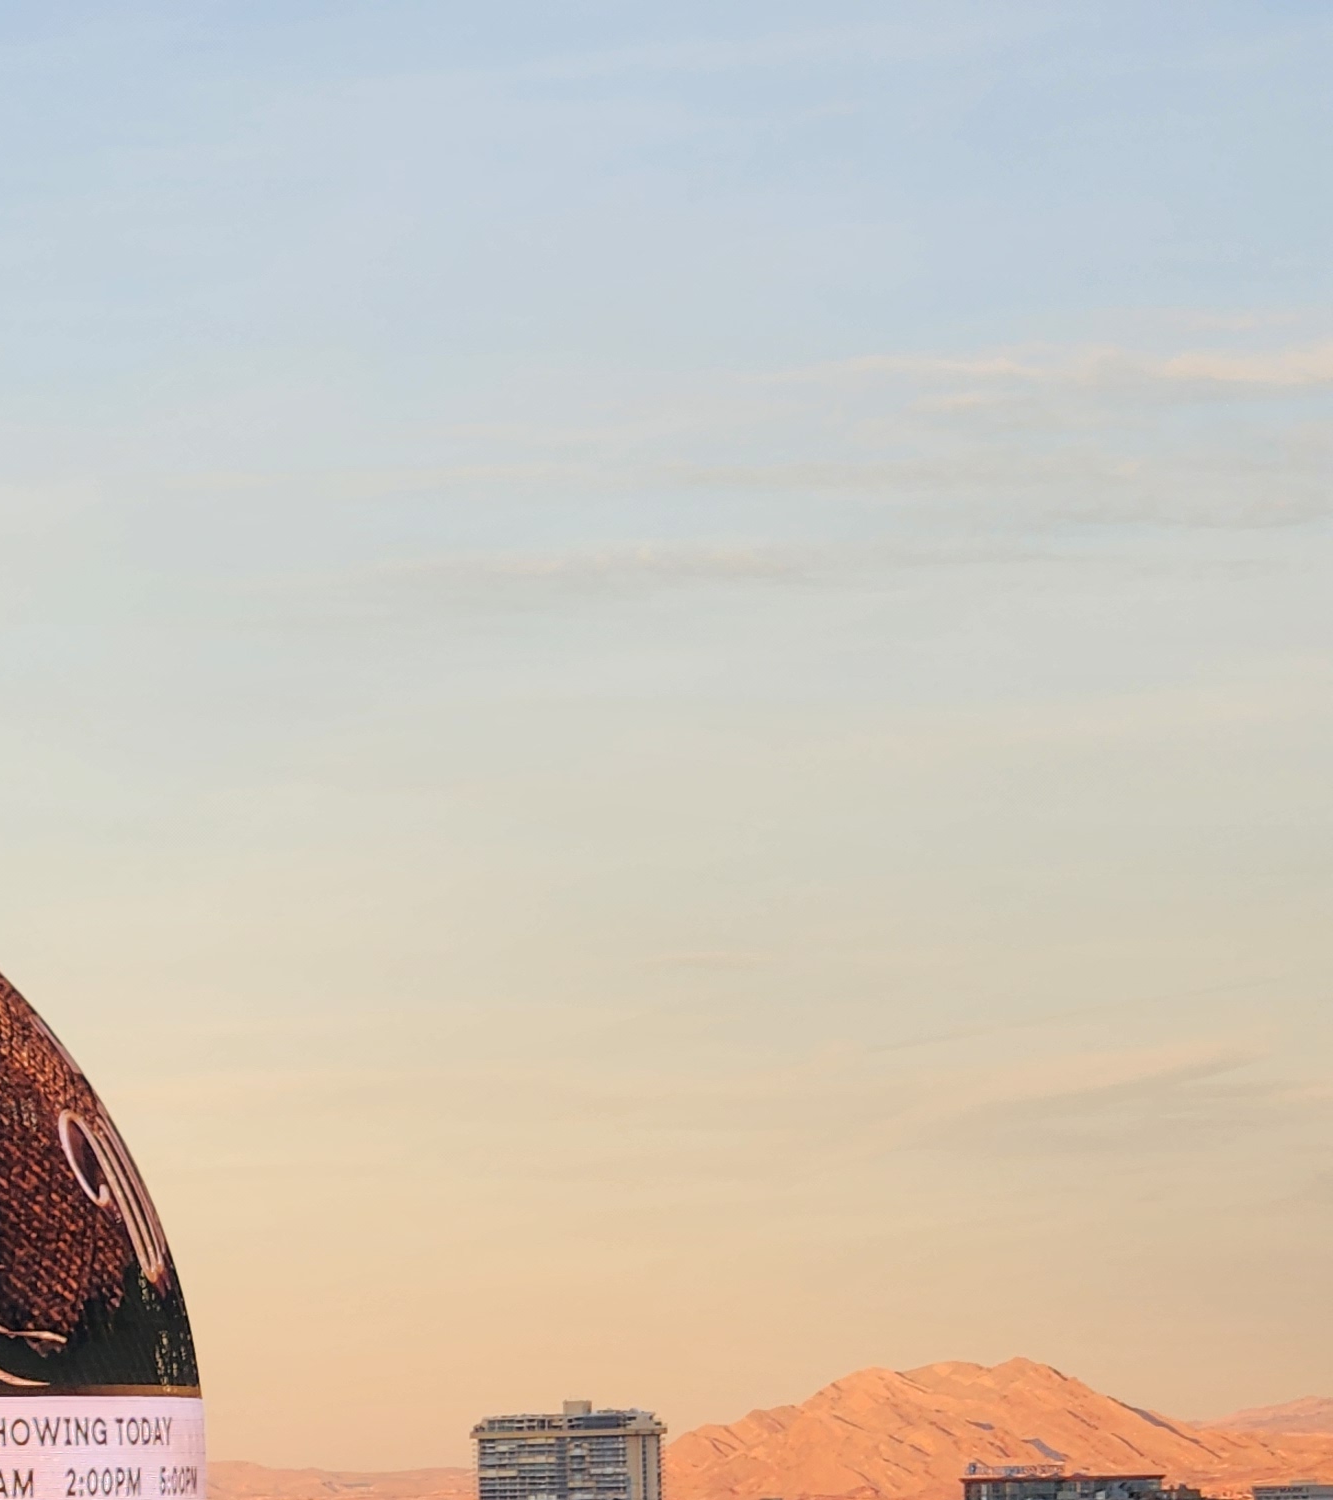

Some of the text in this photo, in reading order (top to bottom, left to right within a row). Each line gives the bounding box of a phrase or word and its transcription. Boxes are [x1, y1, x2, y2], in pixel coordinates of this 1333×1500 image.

[117, 1416, 173, 1447] TODAY
[66, 1467, 142, 1498] 2:00PM
[158, 1465, 198, 1496] 5:00PM
